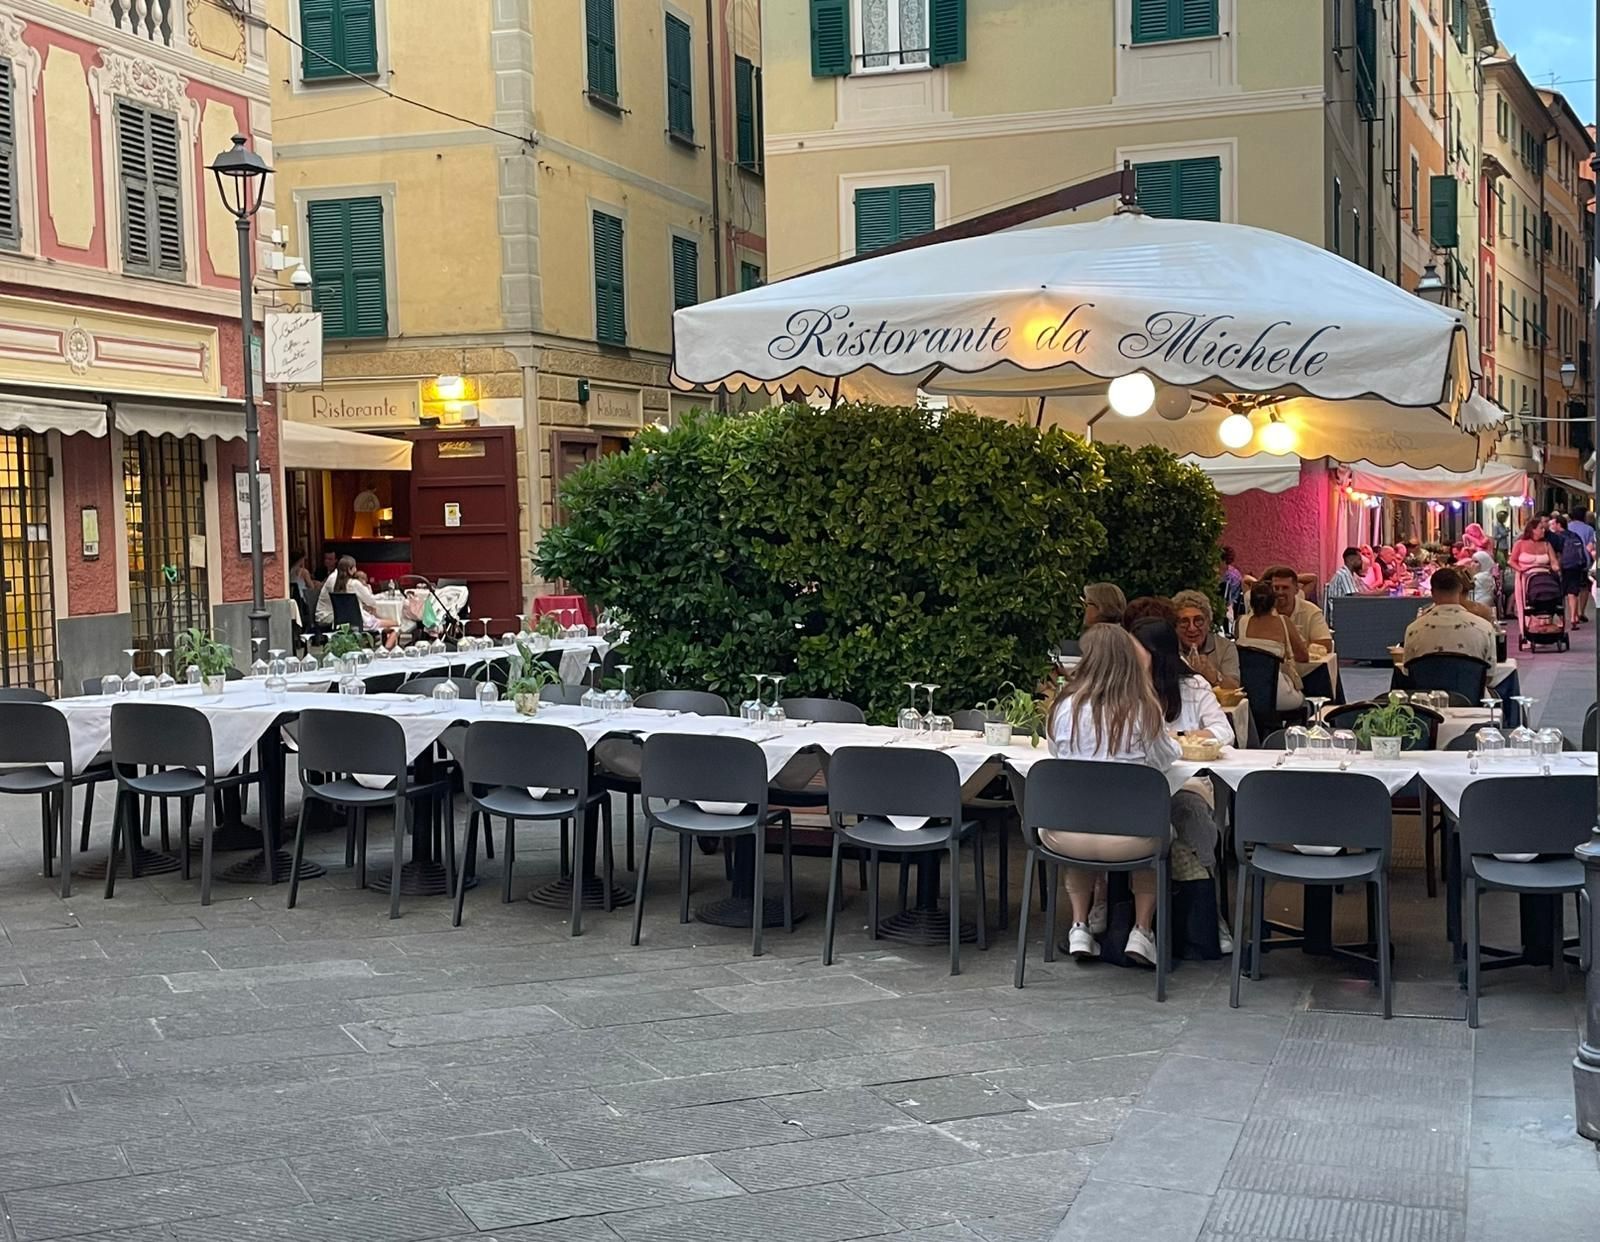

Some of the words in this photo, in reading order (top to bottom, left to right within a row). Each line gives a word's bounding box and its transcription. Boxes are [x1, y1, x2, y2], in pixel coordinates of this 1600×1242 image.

[768, 305, 1011, 360] Ristorante
[1036, 303, 1095, 353] da
[1118, 310, 1341, 377] Michele
[312, 395, 398, 418] Ristorante
